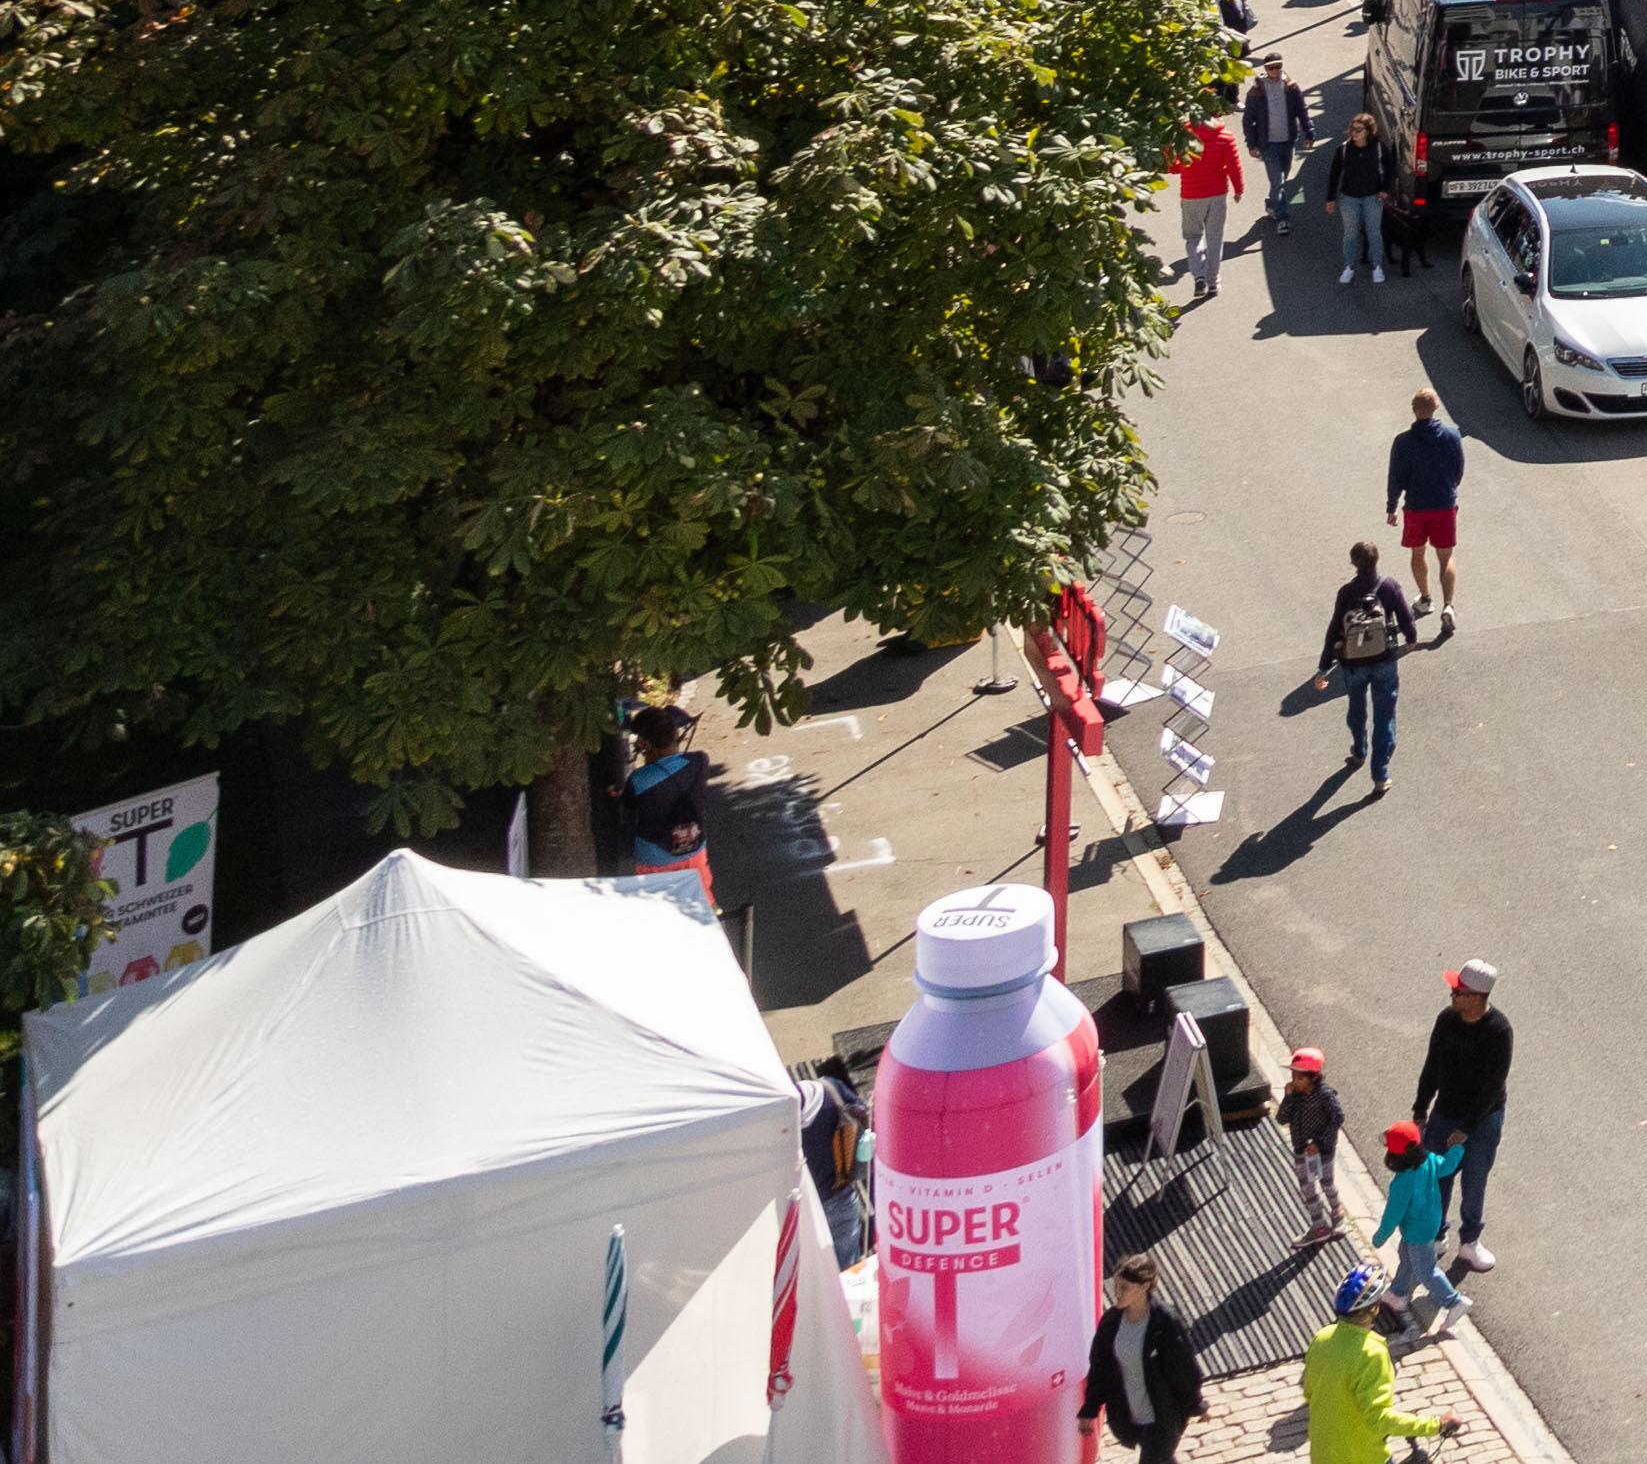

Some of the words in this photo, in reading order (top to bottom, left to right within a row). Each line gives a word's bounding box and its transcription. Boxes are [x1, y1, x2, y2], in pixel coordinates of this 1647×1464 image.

[1494, 44, 1590, 63] TROPHY
[1495, 67, 1528, 80] BIKE
[1530, 67, 1540, 78] &
[1542, 64, 1590, 79] SPORT
[1452, 145, 1585, 161] www.trophy-sport.ch
[110, 797, 174, 832] SUPER
[119, 884, 193, 916] SCHWEIZER
[909, 1186, 974, 1198] VITAMIN
[1017, 1161, 1062, 1186] SELEN
[889, 1200, 1021, 1246] SUPER
[902, 1253, 999, 1271] DEFENCE
[935, 1384, 1017, 1402] Goldmelisse
